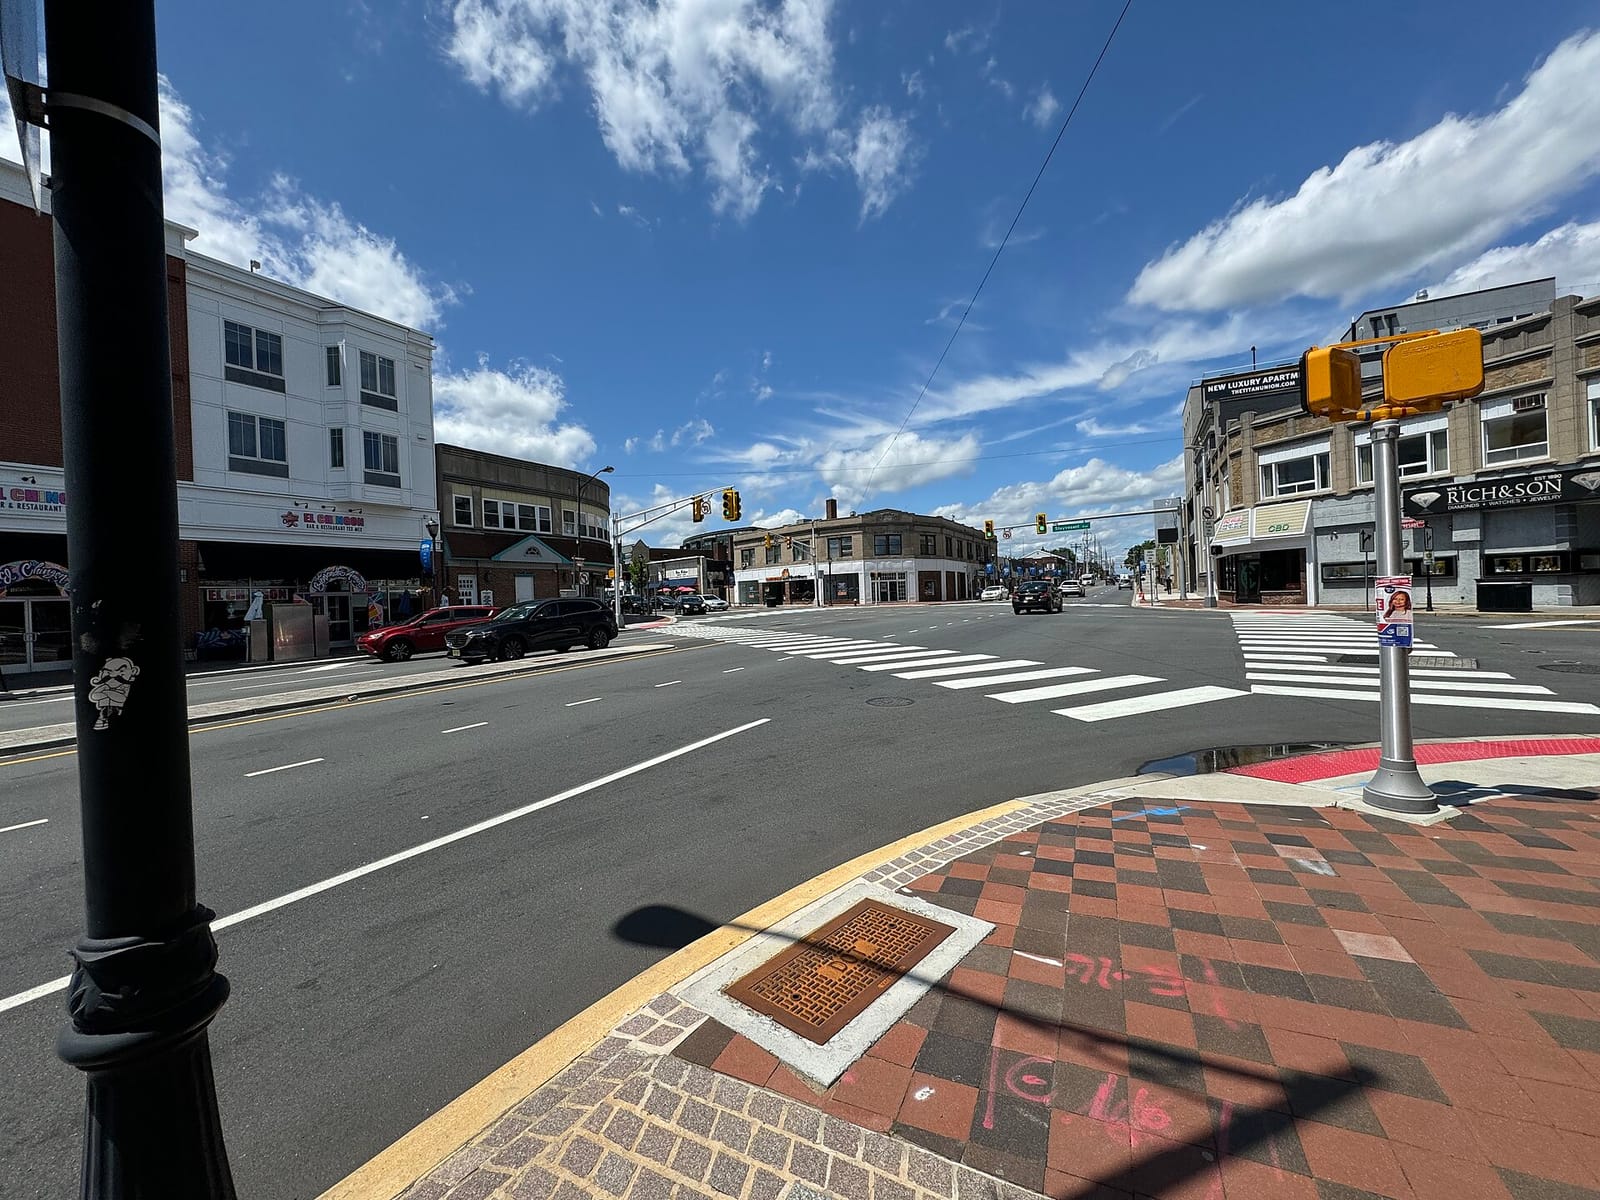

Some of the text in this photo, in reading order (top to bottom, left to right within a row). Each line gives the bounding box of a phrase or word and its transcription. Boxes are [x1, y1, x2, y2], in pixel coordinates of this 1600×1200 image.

[1207, 372, 1299, 393] NEW LUXURY APARTM
[1231, 381, 1295, 395] THETITANUNION.COM
[1447, 479, 1562, 503] RICH&SON
[17, 502, 62, 512] RESTAURANT
[1447, 494, 1562, 510] DIAMONDS WATCHES JEWELRY
[303, 513, 316, 523] EL
[1268, 523, 1290, 532] CBD
[208, 589, 287, 600] EL CHON
